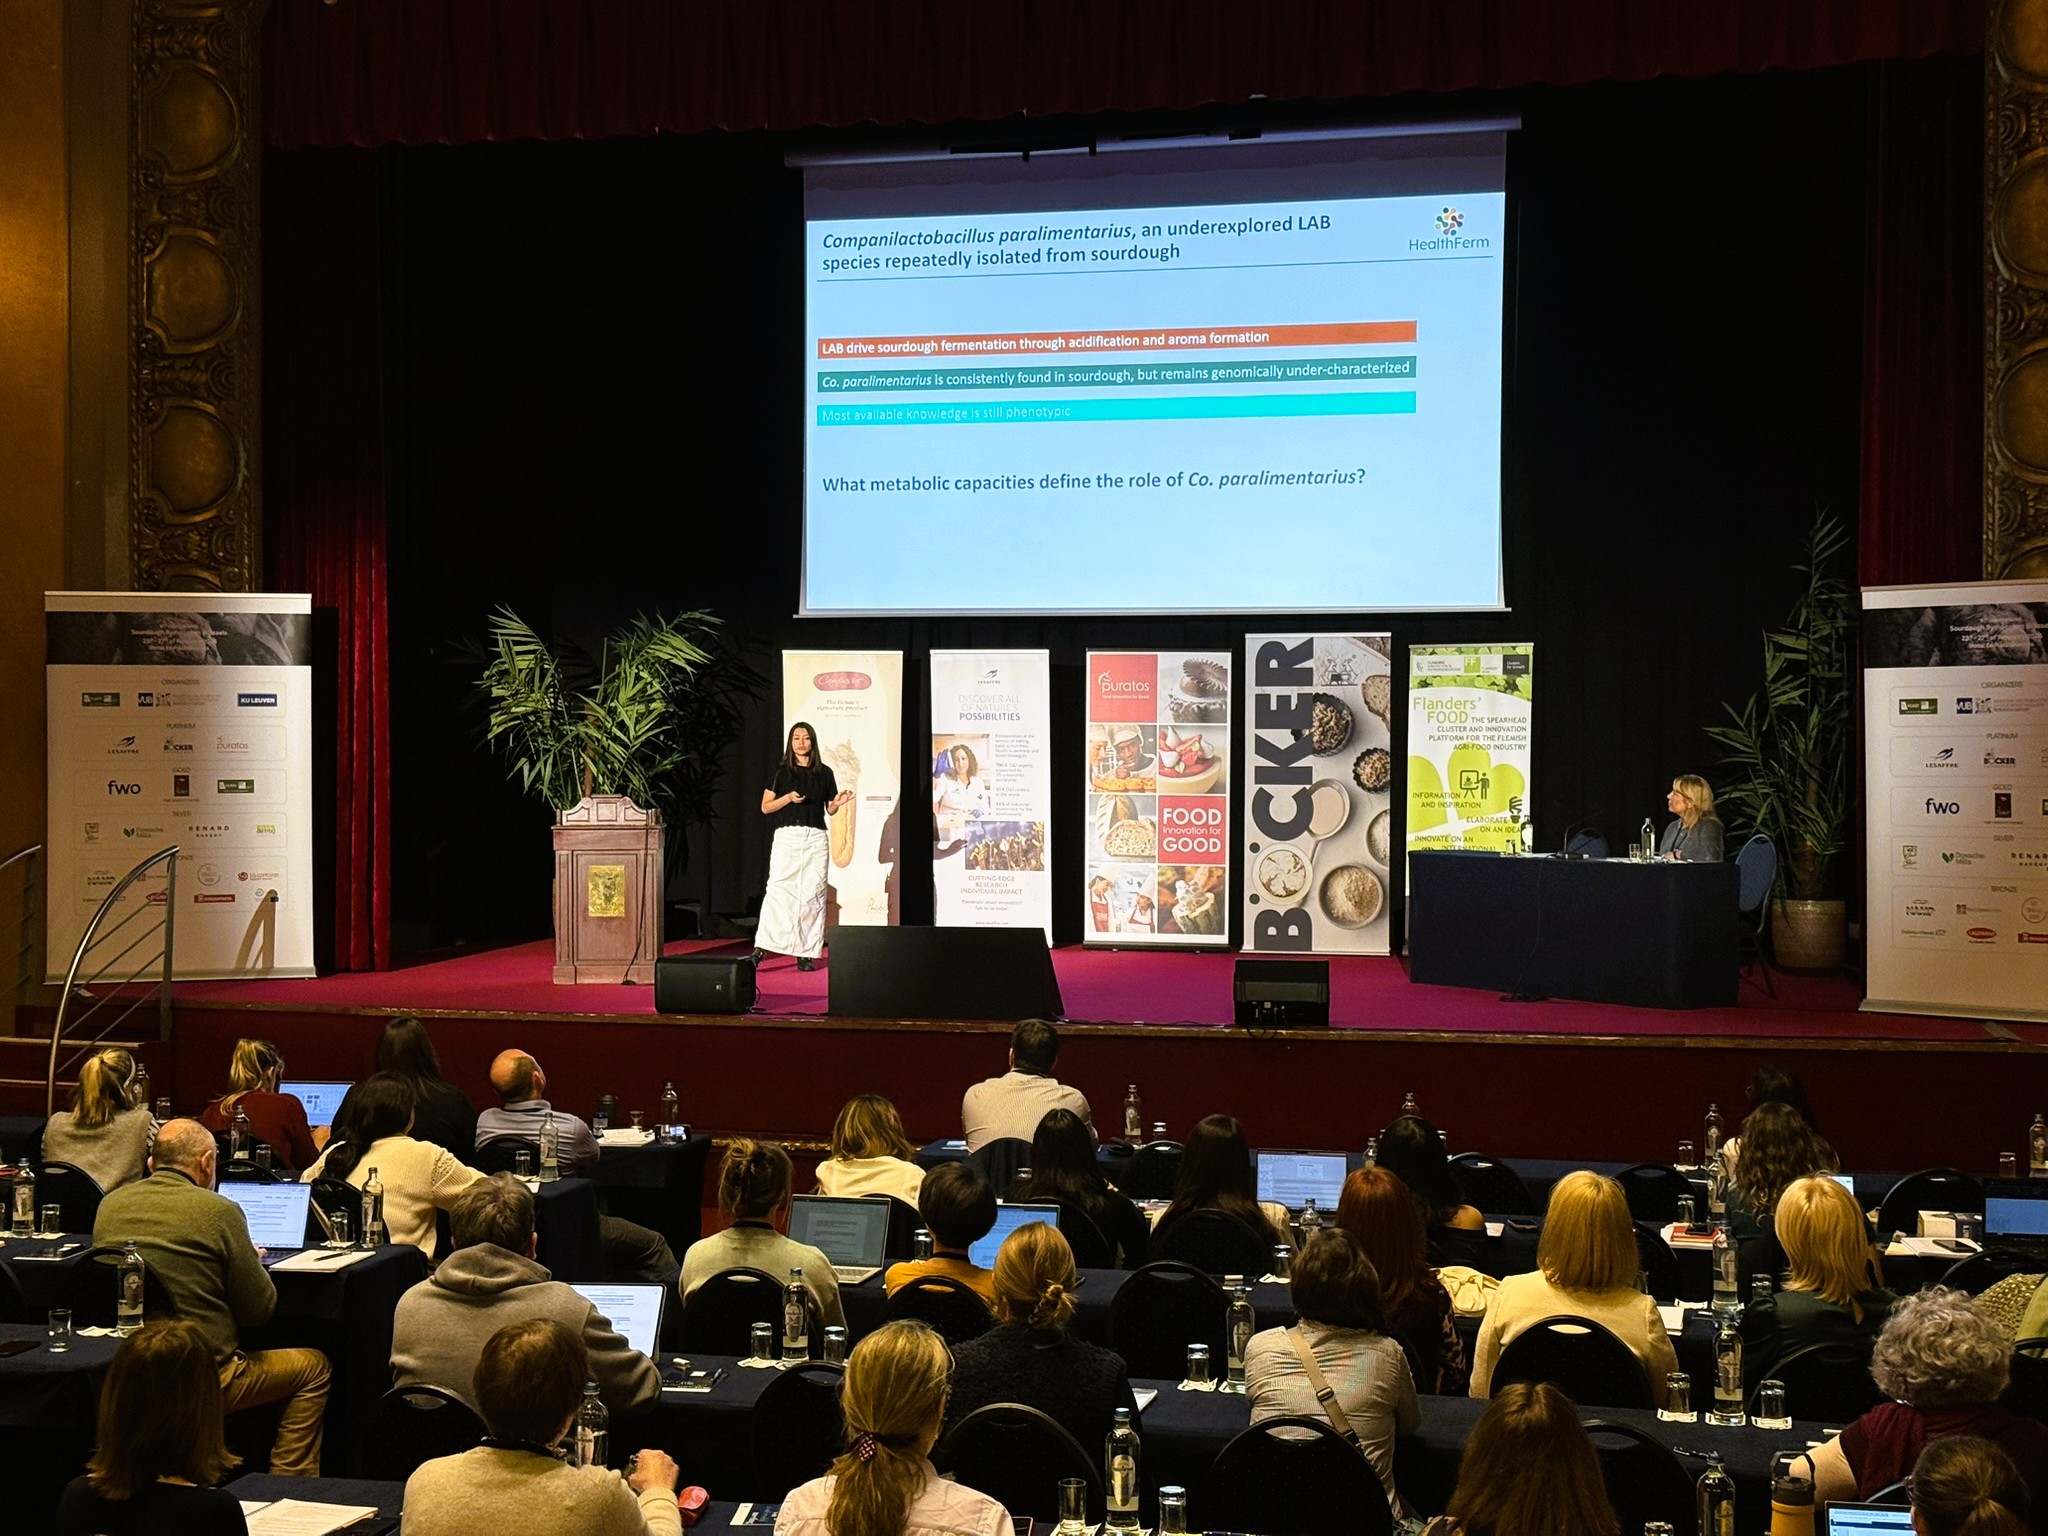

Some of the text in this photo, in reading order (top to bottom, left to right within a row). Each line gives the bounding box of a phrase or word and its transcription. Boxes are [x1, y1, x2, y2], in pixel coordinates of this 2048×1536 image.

[823, 214, 1331, 250] Companilactobacillus paralimentarius, an underexplored LAB
[1409, 237, 1490, 251] HealthFerm
[822, 243, 1180, 273] species repeatedly isolated from sourdough
[822, 330, 1270, 356] LAB drive sourdough fermentation through acidification and aroma formation
[822, 360, 1410, 390] Co. paralimentarius is consistently found in sourdough, but remains genomically under-characterized
[822, 405, 1071, 422] Most available knowledge is still phenotypic
[822, 468, 1366, 493] What metabolic capacities define the role of Co. paralimentarius?
[1101, 680, 1150, 694] puratos
[958, 694, 1020, 703] DISCOVER ALL
[1413, 697, 1482, 710] Flanders'
[961, 704, 972, 712] OF
[1956, 702, 1972, 710] VUB
[959, 712, 1021, 721] POSSIBILITIES
[1427, 711, 1527, 724] FOOD THE SPEARHEAD
[1436, 725, 1527, 733] CLUSTER AND INNOVATION
[1428, 734, 1527, 742] PLATFORM FOR THE FLEMISH
[1453, 743, 1527, 751] AGRI-FOOD INDUSTRY
[107, 780, 142, 795] fwo
[1437, 801, 1482, 809] INSPIRATION
[1925, 797, 1960, 815] fwo
[1163, 807, 1222, 826] FOOD
[1466, 816, 1508, 824] ELABORATE
[1162, 825, 1222, 835] Innovation for
[1479, 825, 1491, 833] ON
[1162, 836, 1222, 853] GOOD
[1414, 835, 1449, 843] INNOVATE
[1450, 835, 1463, 843] ON
